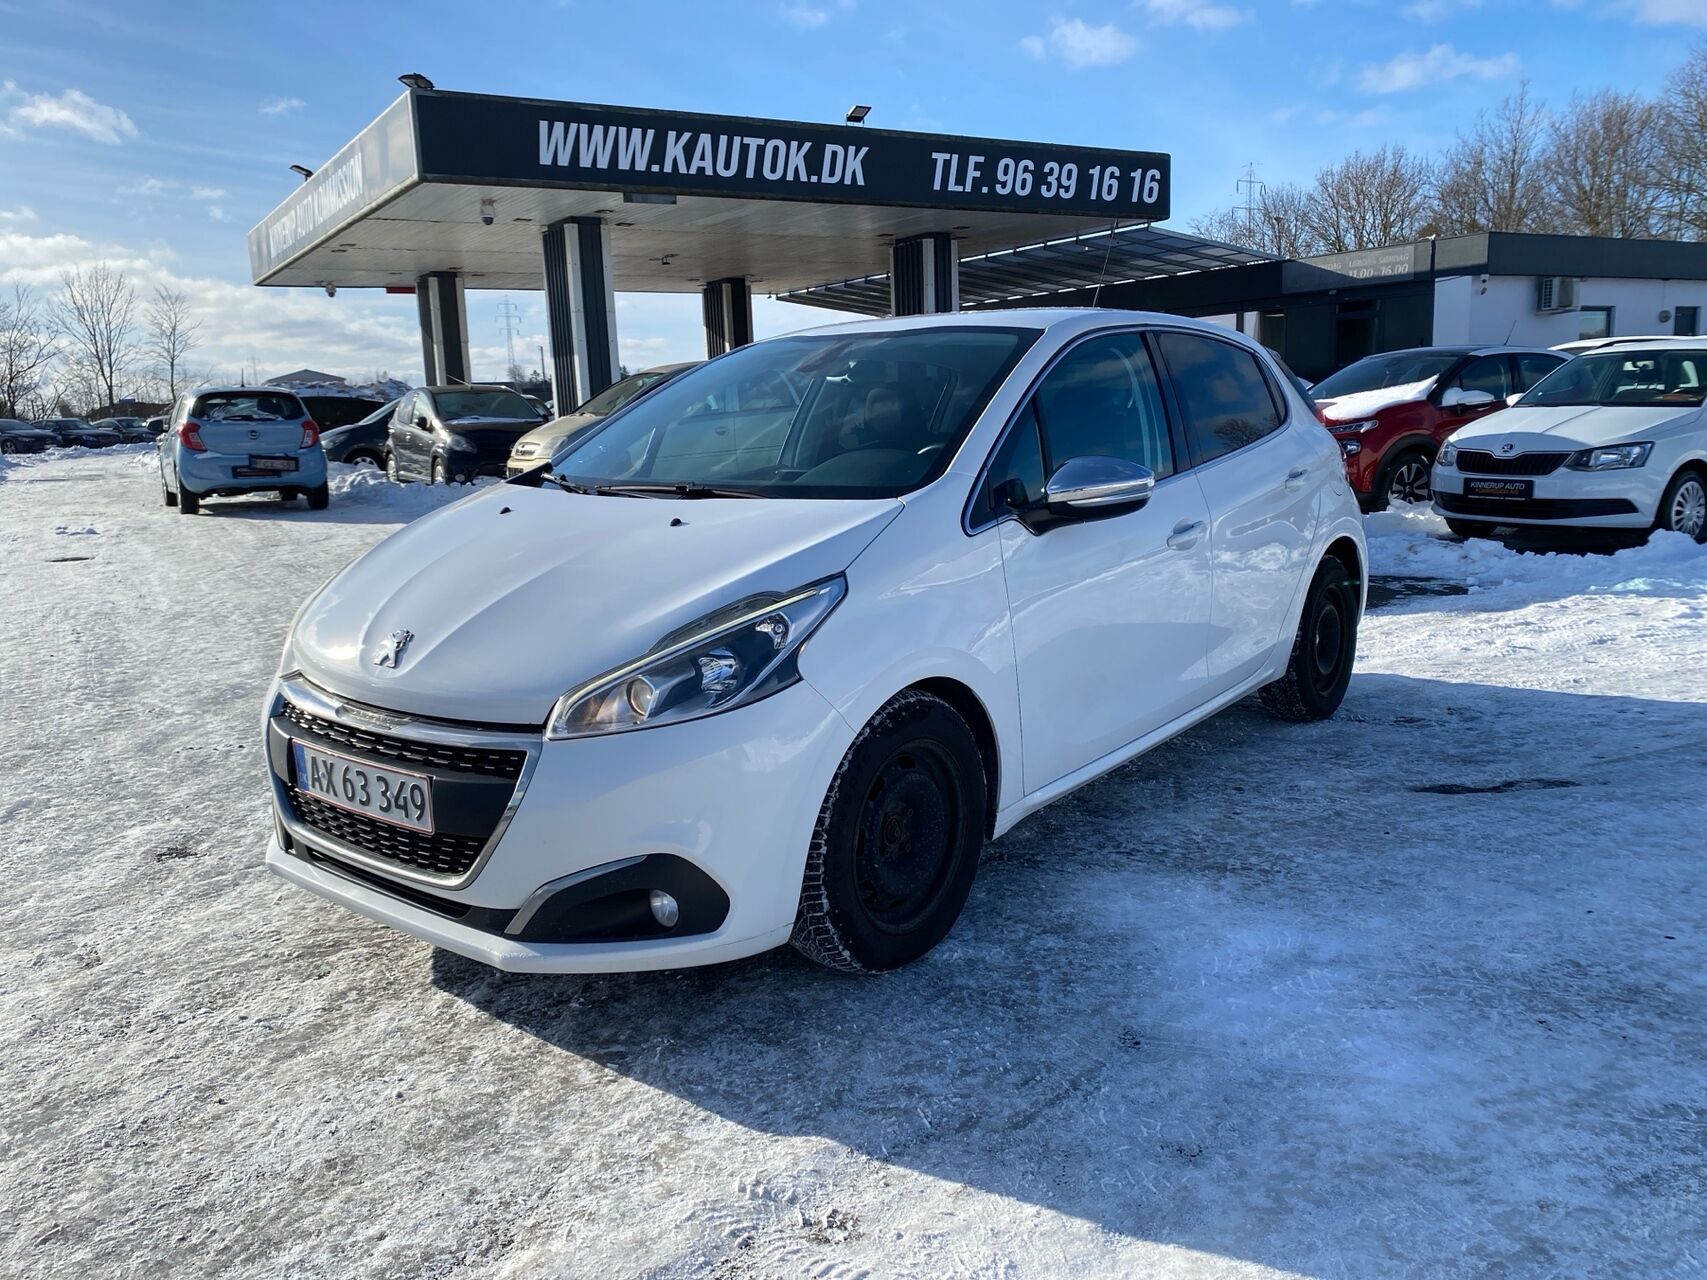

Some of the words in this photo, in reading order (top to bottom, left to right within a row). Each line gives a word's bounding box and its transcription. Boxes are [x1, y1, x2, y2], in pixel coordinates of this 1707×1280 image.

[538, 119, 870, 186] WWW.KAUTOK.DK
[931, 152, 988, 194] TLF.
[995, 157, 1035, 196] 96
[1040, 161, 1078, 200] 39
[1088, 165, 1120, 202] 16
[1130, 168, 1161, 204] 16
[1381, 263, 1409, 276] 16.00
[311, 755, 338, 798] AX
[342, 765, 371, 807] 63
[376, 775, 425, 822] 349
